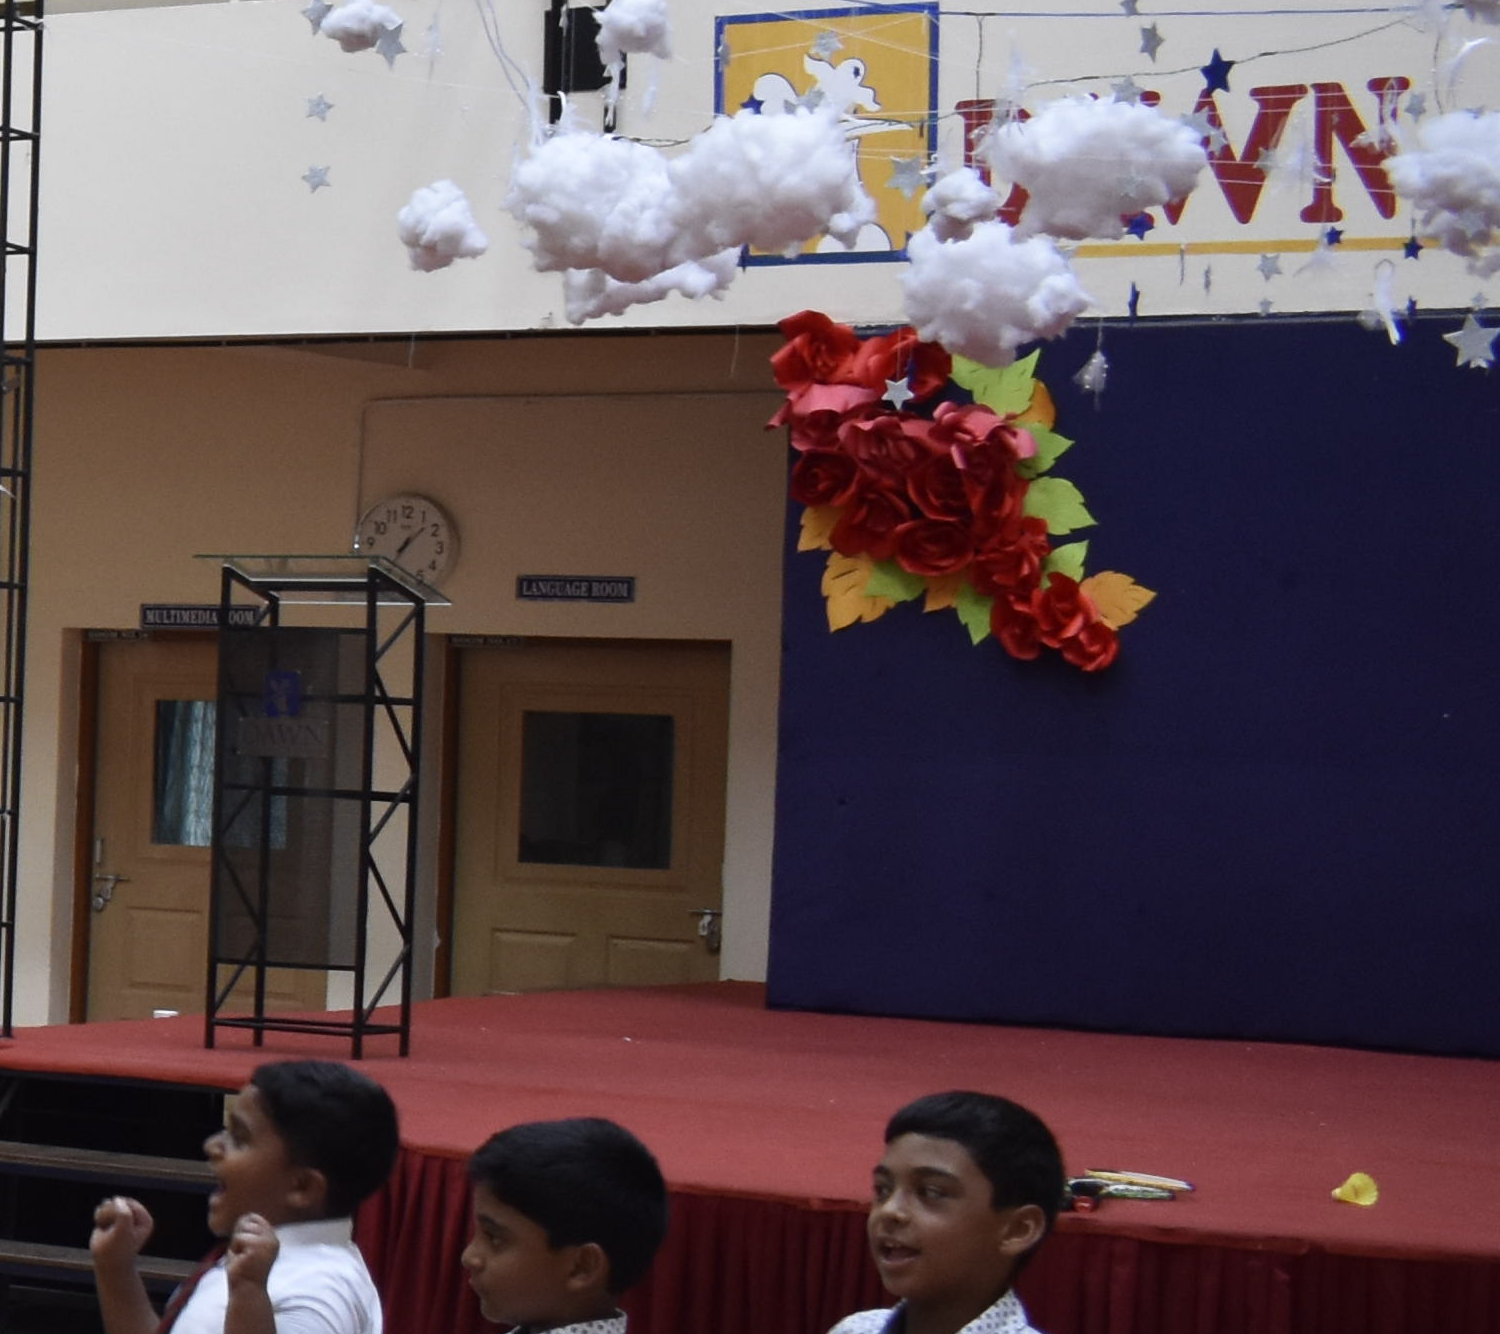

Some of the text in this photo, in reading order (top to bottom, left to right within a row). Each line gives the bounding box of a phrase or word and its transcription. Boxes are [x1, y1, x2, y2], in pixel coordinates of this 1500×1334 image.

[431, 523, 440, 537] 2
[435, 541, 444, 555] 3
[522, 580, 628, 598] LANGUAGE ROOM
[144, 608, 255, 625] MULTIMEDIA OOM
[243, 722, 324, 747] DAWN
